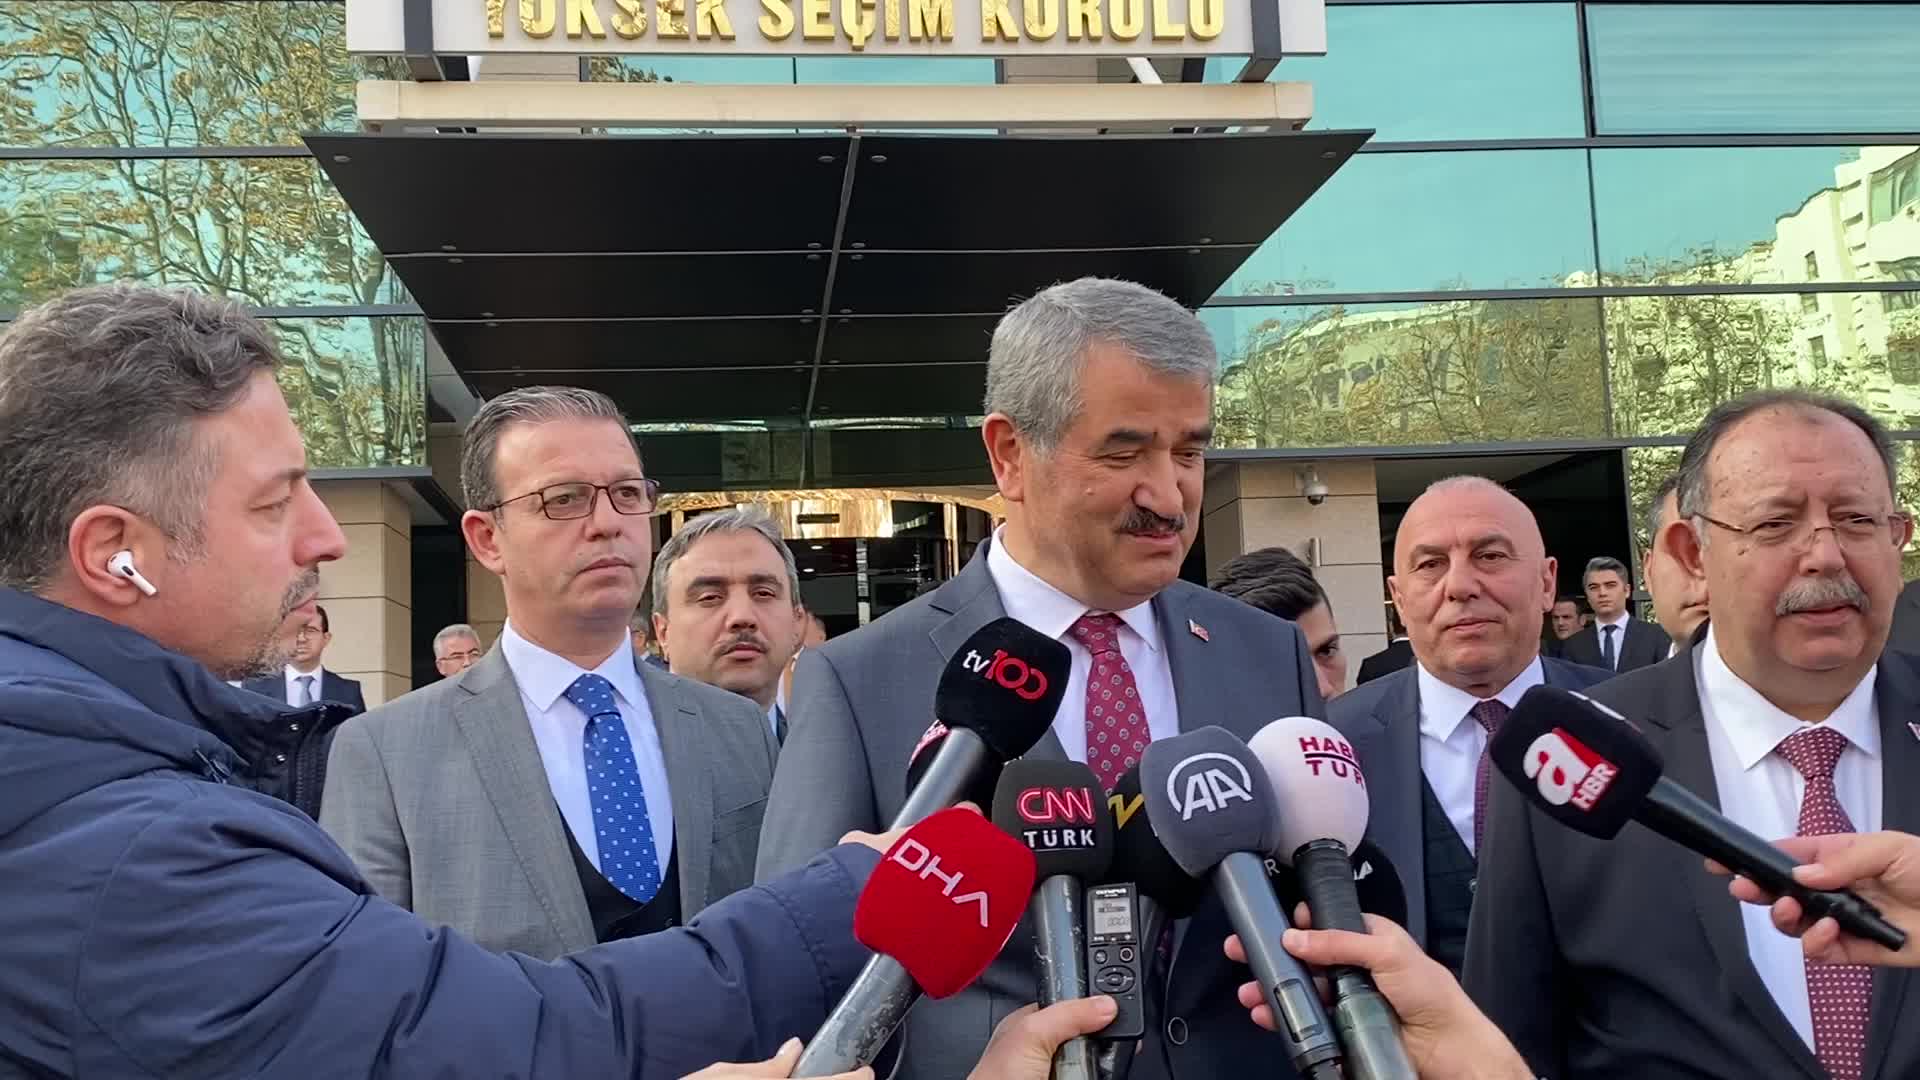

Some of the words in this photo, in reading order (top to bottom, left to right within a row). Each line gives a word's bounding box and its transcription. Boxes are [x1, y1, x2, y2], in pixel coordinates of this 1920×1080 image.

[980, 0, 1225, 42] KURULU
[1017, 787, 1096, 824] CNN
[1182, 768, 1254, 821] AA
[1023, 828, 1096, 848] TÜRK
[890, 838, 989, 928] DHA
